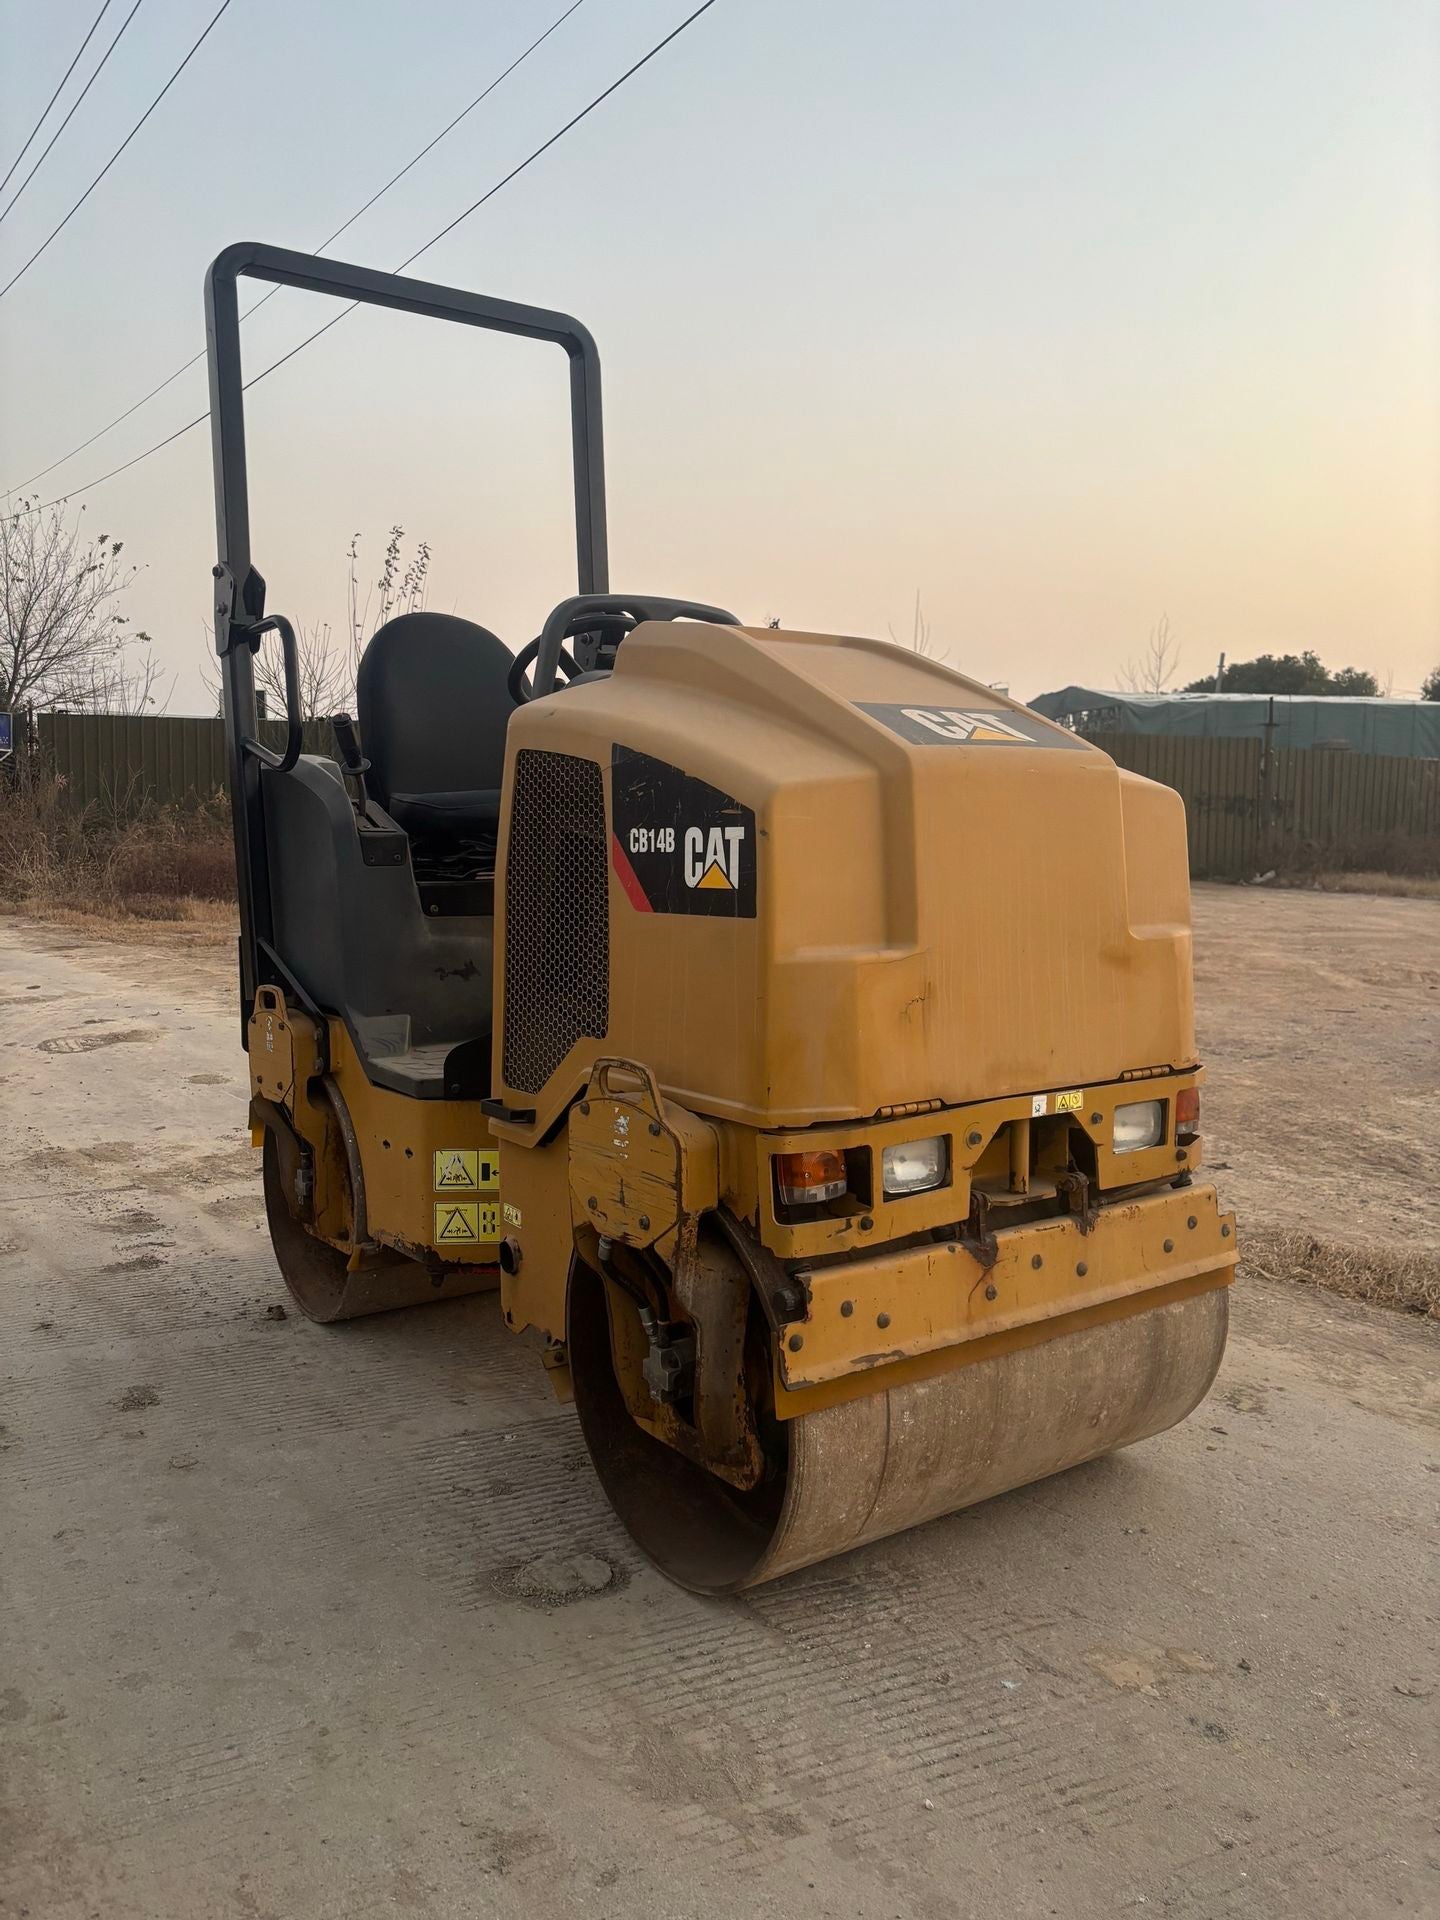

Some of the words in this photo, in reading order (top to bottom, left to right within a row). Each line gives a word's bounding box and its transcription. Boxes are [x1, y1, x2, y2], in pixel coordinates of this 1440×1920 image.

[900, 709, 1037, 742] CAT
[629, 828, 675, 853] CB14B
[684, 827, 744, 889] CAT
